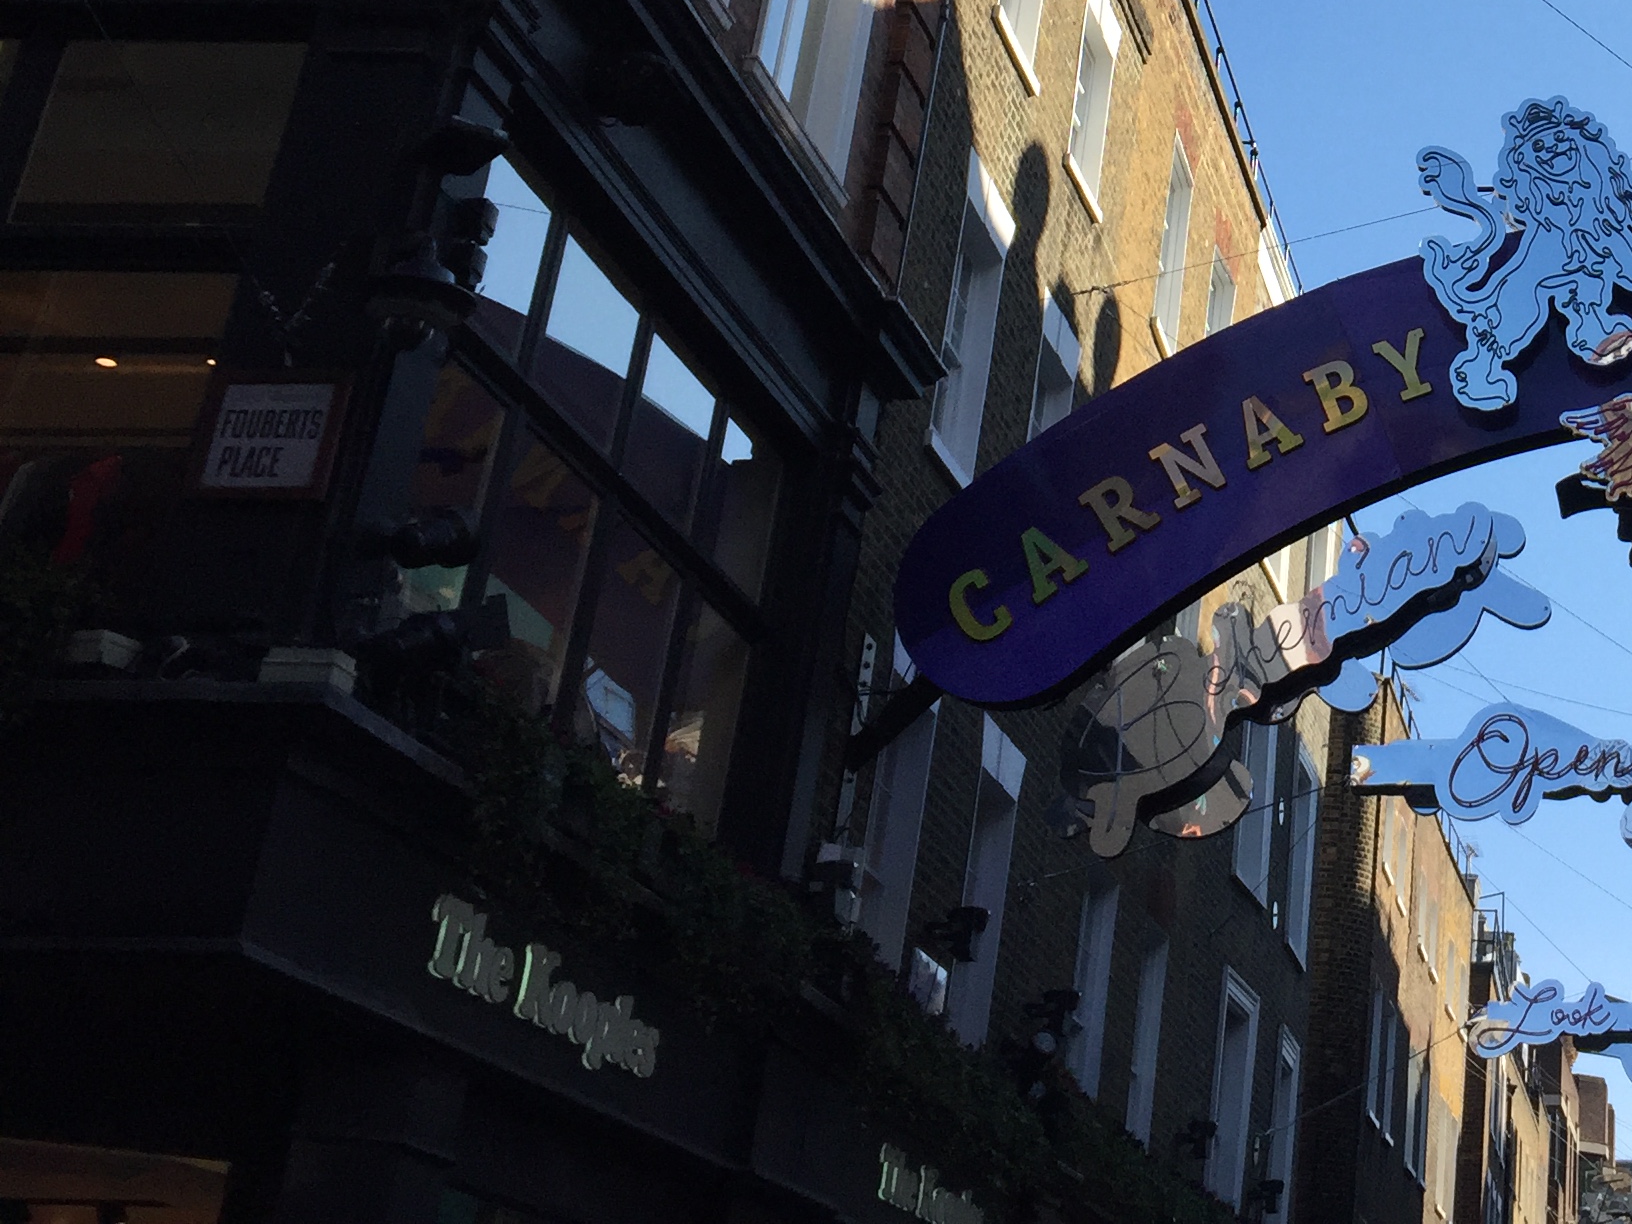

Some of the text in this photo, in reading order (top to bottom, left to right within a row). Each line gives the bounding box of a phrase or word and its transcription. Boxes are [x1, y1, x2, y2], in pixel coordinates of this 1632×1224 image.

[216, 445, 284, 477] PLACE
[948, 327, 1433, 642] CARNABY
[427, 893, 515, 1004] The
[1477, 984, 1611, 1051] Look
